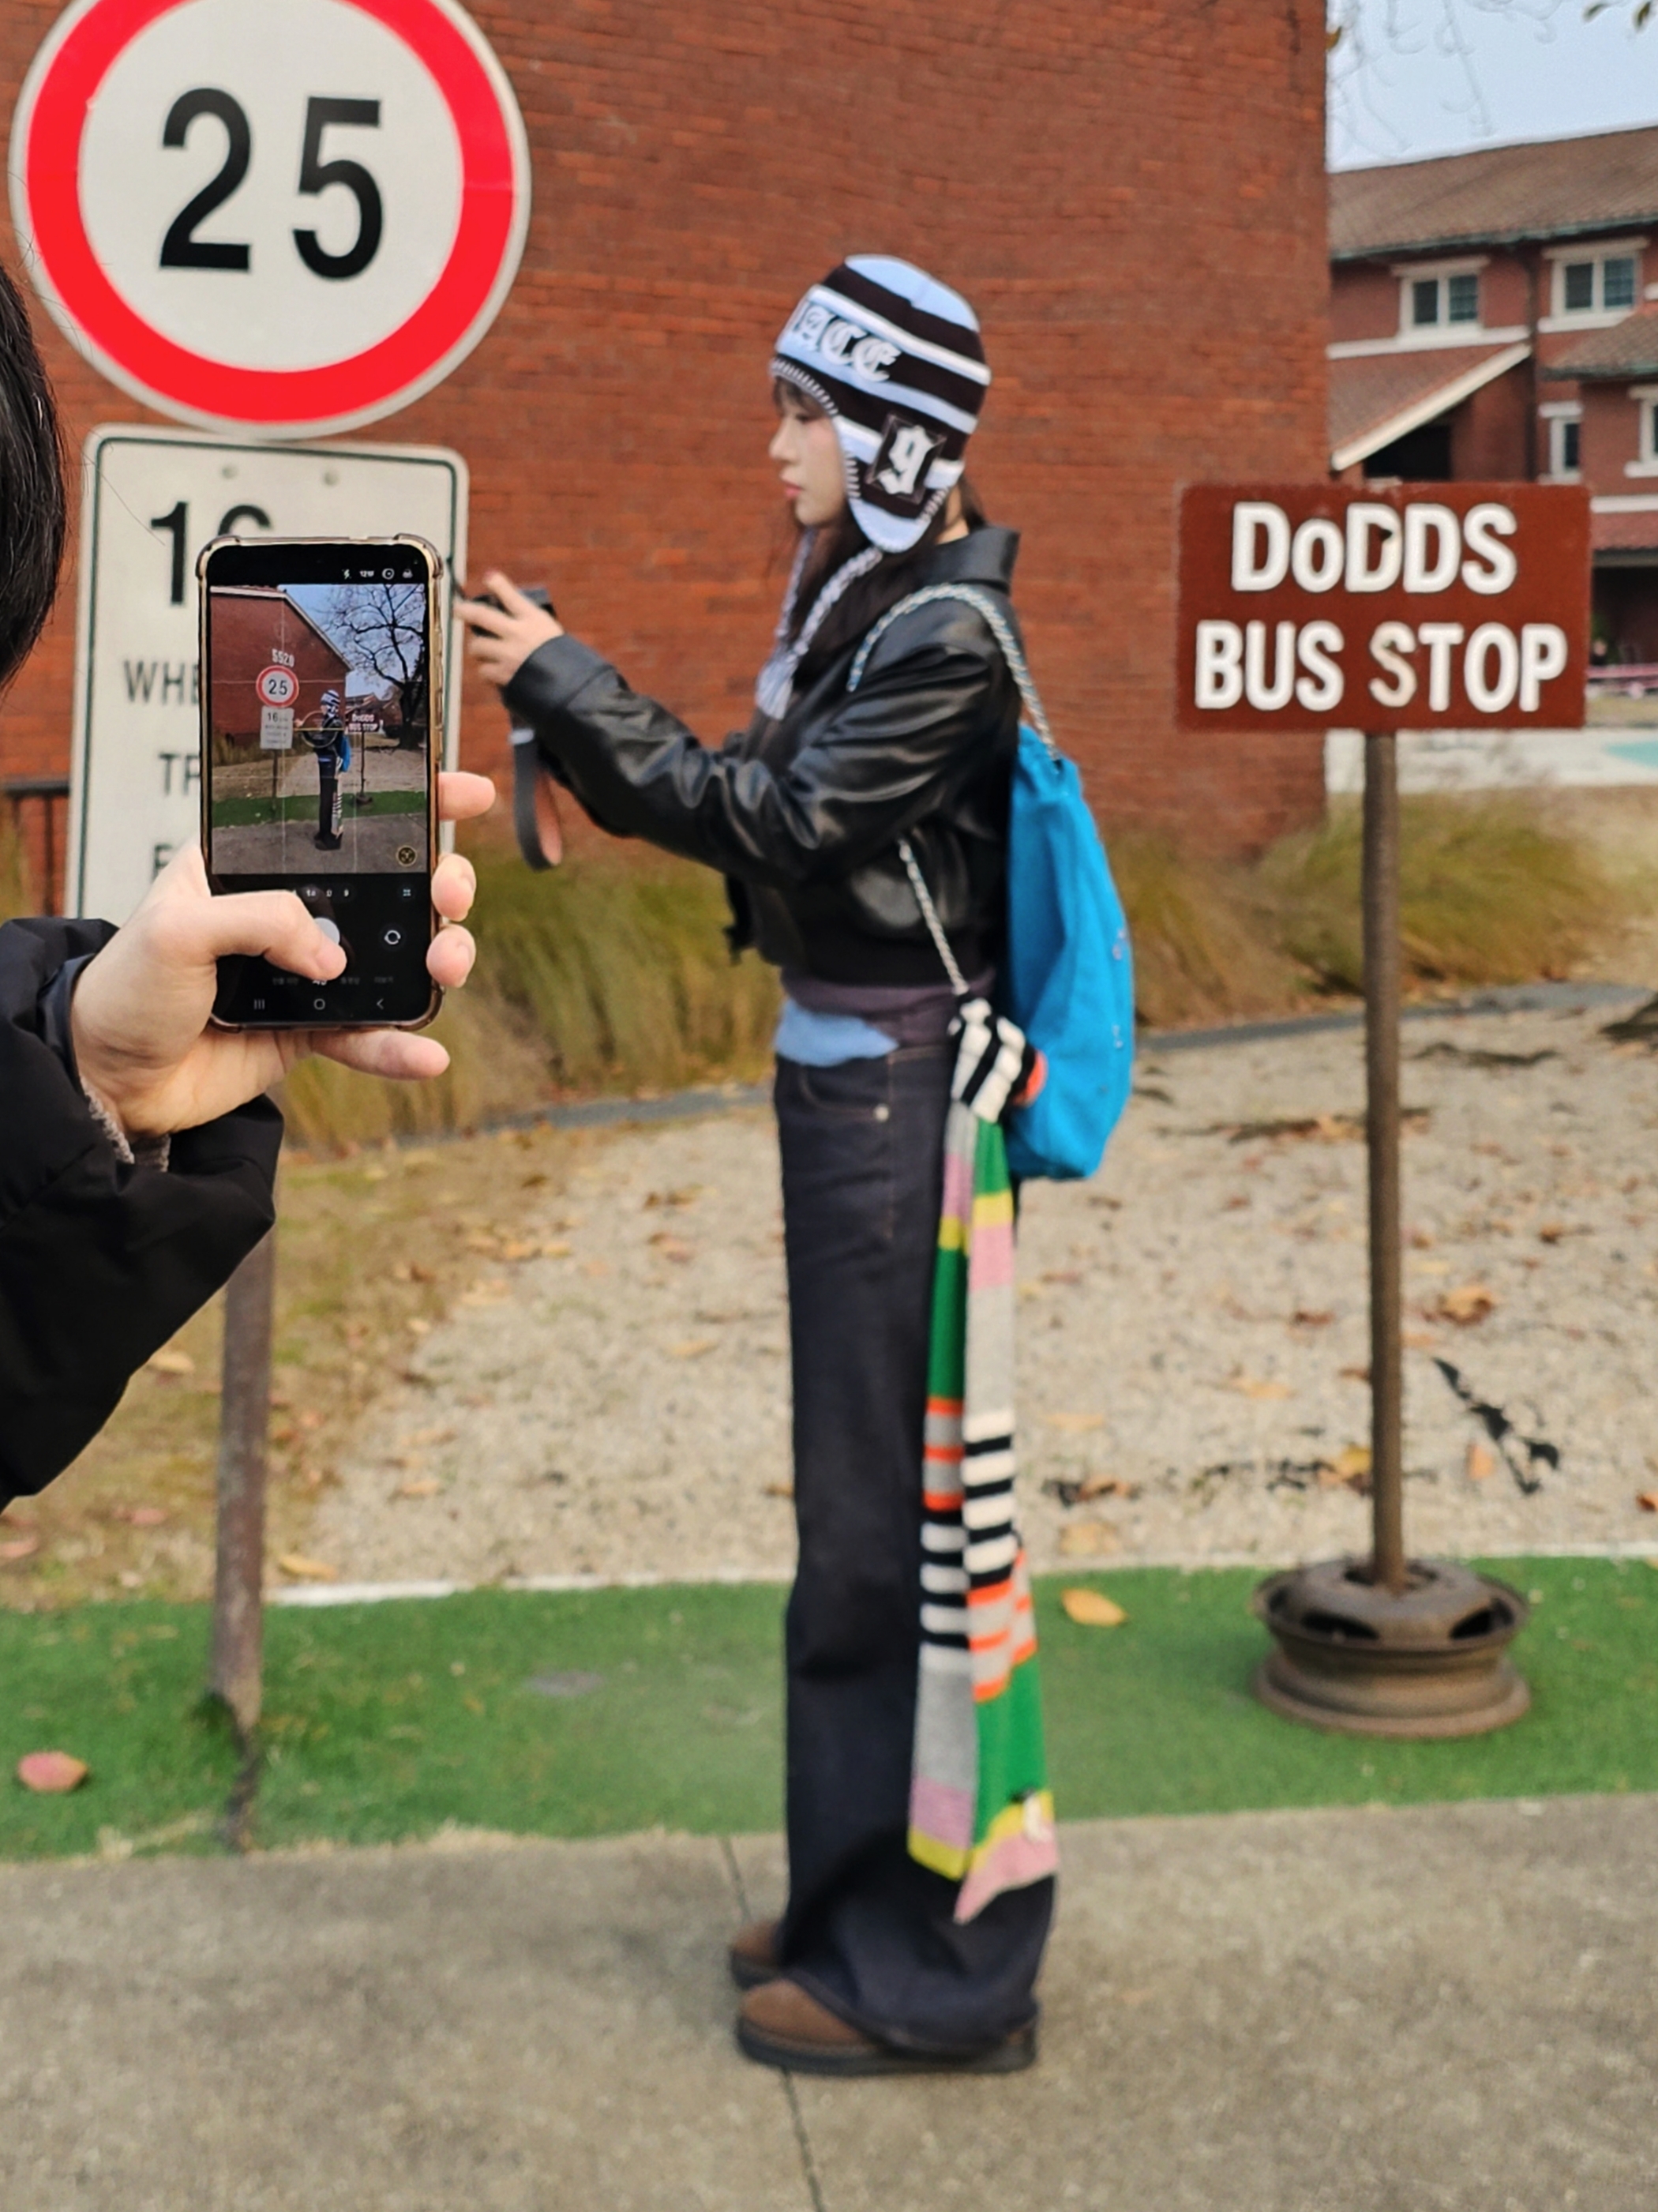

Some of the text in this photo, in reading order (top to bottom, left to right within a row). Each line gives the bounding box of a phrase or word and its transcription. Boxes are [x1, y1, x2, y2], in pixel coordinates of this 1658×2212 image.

[159, 88, 383, 280] 25
[1231, 501, 1517, 595] DoDDS
[268, 678, 287, 696] 25
[1195, 619, 1568, 712] BUS STOP
